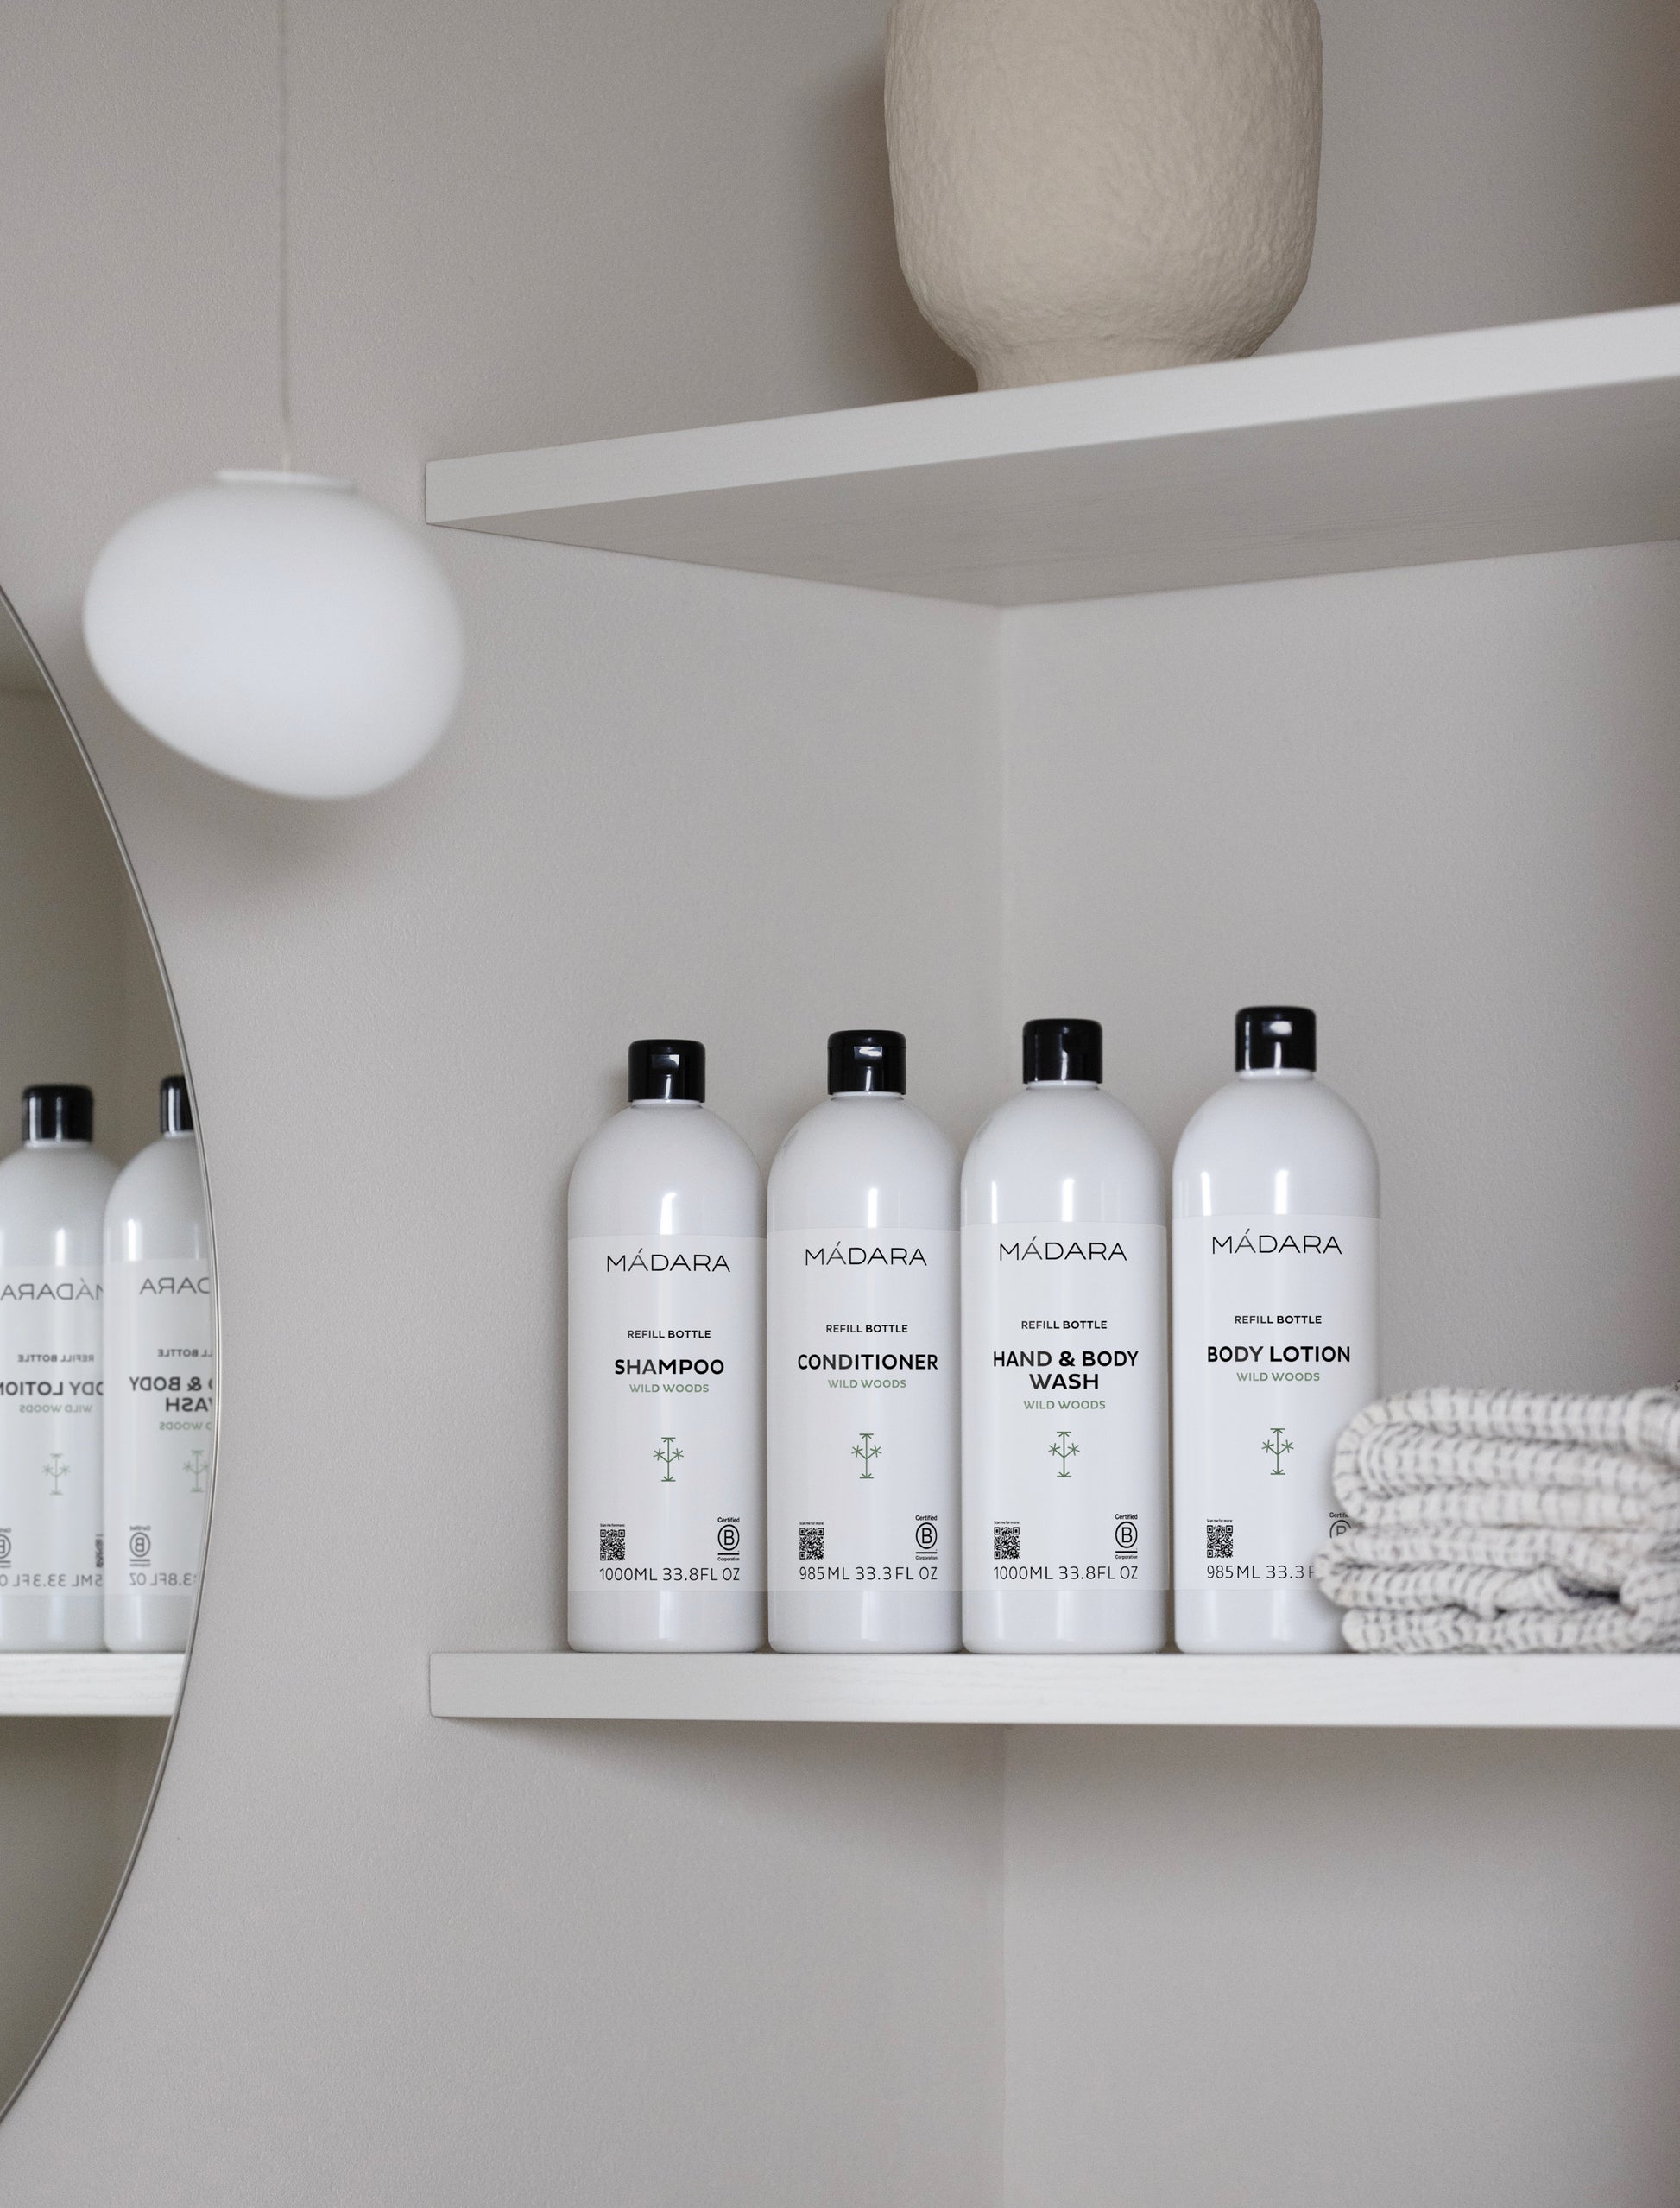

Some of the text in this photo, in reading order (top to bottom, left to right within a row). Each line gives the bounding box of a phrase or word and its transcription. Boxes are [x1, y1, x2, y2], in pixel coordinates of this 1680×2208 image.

[999, 1236, 1127, 1261] MÁDARA
[1212, 1228, 1342, 1255] MÁDARA
[607, 1248, 730, 1273] MÁDARA
[805, 1241, 927, 1266] MÁDARA
[1021, 1320, 1108, 1329] REFILL BOTTLE
[1235, 1315, 1322, 1324] REFILL BOTTLE
[628, 1330, 711, 1338] REFILL BOTTLE
[993, 1351, 1139, 1367] HAND & BODY
[1207, 1346, 1350, 1363] BODY LOTION
[615, 1359, 724, 1376] SHAMPOO
[798, 1354, 938, 1370] CONDITIONER
[1029, 1374, 1098, 1389] WASH
[1236, 1372, 1320, 1381] WILD WOODS
[629, 1384, 709, 1393] WILD WOODS
[861, 1380, 906, 1389] WOODS
[1023, 1401, 1105, 1409] WILD WOODS
[599, 1567, 658, 1581] 1000ML
[722, 1567, 740, 1581] OZ
[919, 1566, 938, 1580] OZ
[994, 1566, 1053, 1580] 1000ML
[1120, 1566, 1138, 1579] OZ
